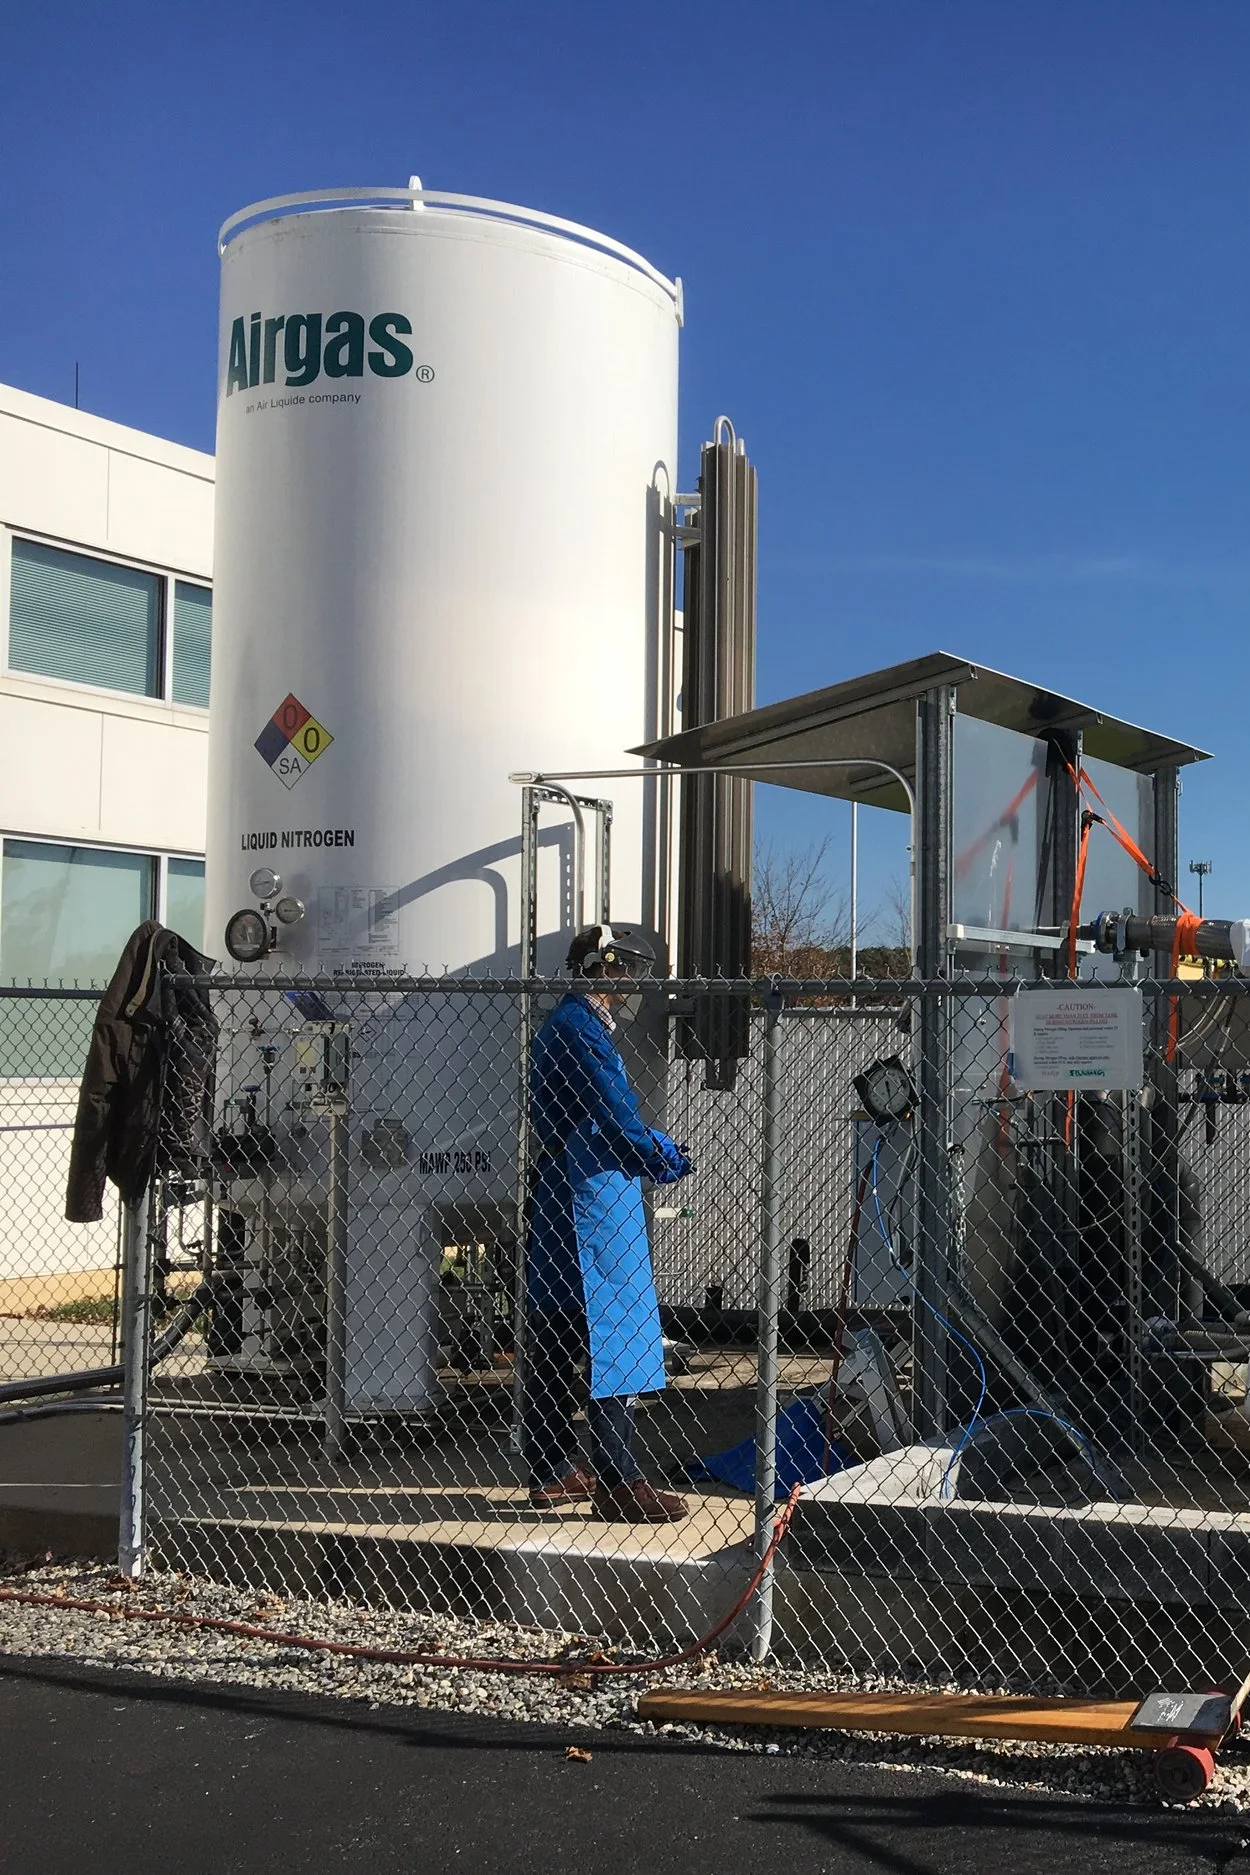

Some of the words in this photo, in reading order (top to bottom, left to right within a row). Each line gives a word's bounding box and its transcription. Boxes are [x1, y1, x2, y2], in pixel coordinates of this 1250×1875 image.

[226, 311, 414, 398] Airgas
[257, 401, 269, 411] Air
[270, 395, 306, 408] Liquide
[308, 393, 362, 404] company
[283, 704, 298, 731] 0
[303, 727, 320, 753] 0
[279, 757, 302, 775] SA
[241, 832, 278, 851] LIQUID
[281, 830, 355, 848] NITROGEN
[419, 1152, 451, 1174] MAWP
[475, 1150, 491, 1173] PSI
